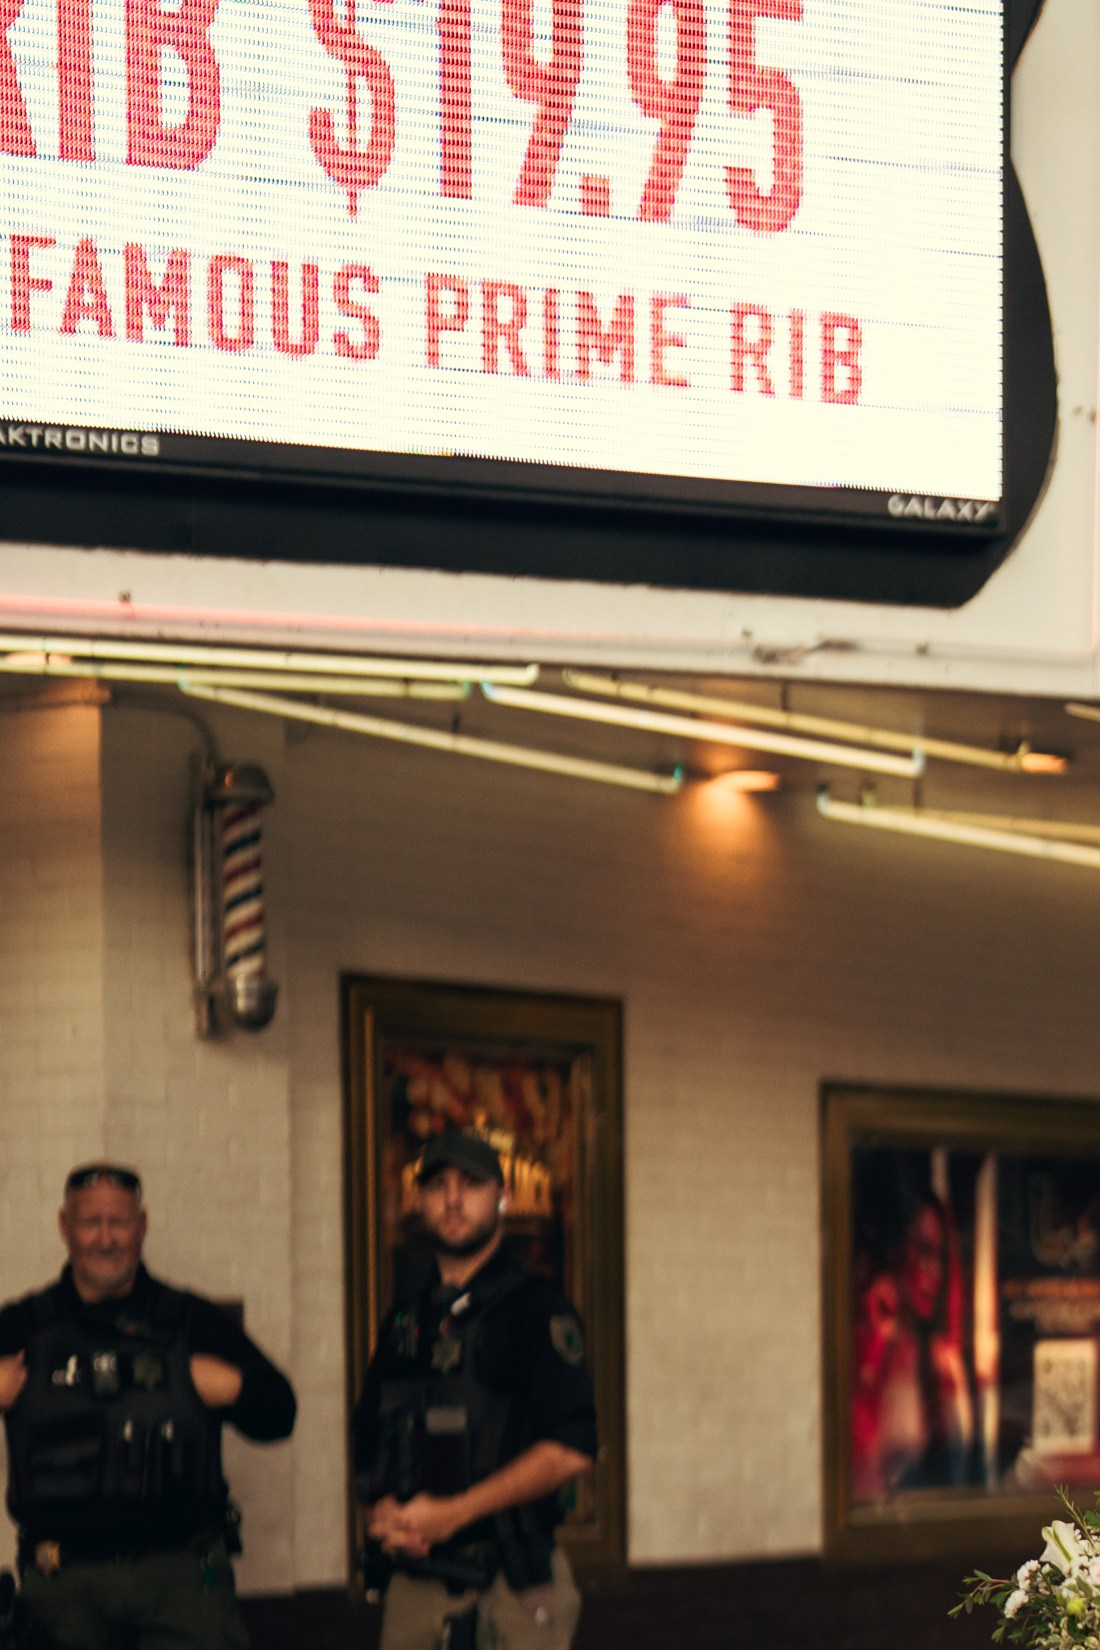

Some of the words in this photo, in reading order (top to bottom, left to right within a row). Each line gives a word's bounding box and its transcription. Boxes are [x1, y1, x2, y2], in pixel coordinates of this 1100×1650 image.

[308, 0, 803, 234] $19.95
[9, 234, 381, 360] FAMOUS
[424, 272, 691, 388] PRIME
[729, 302, 862, 405] RIB
[887, 494, 992, 523] GALAXY
